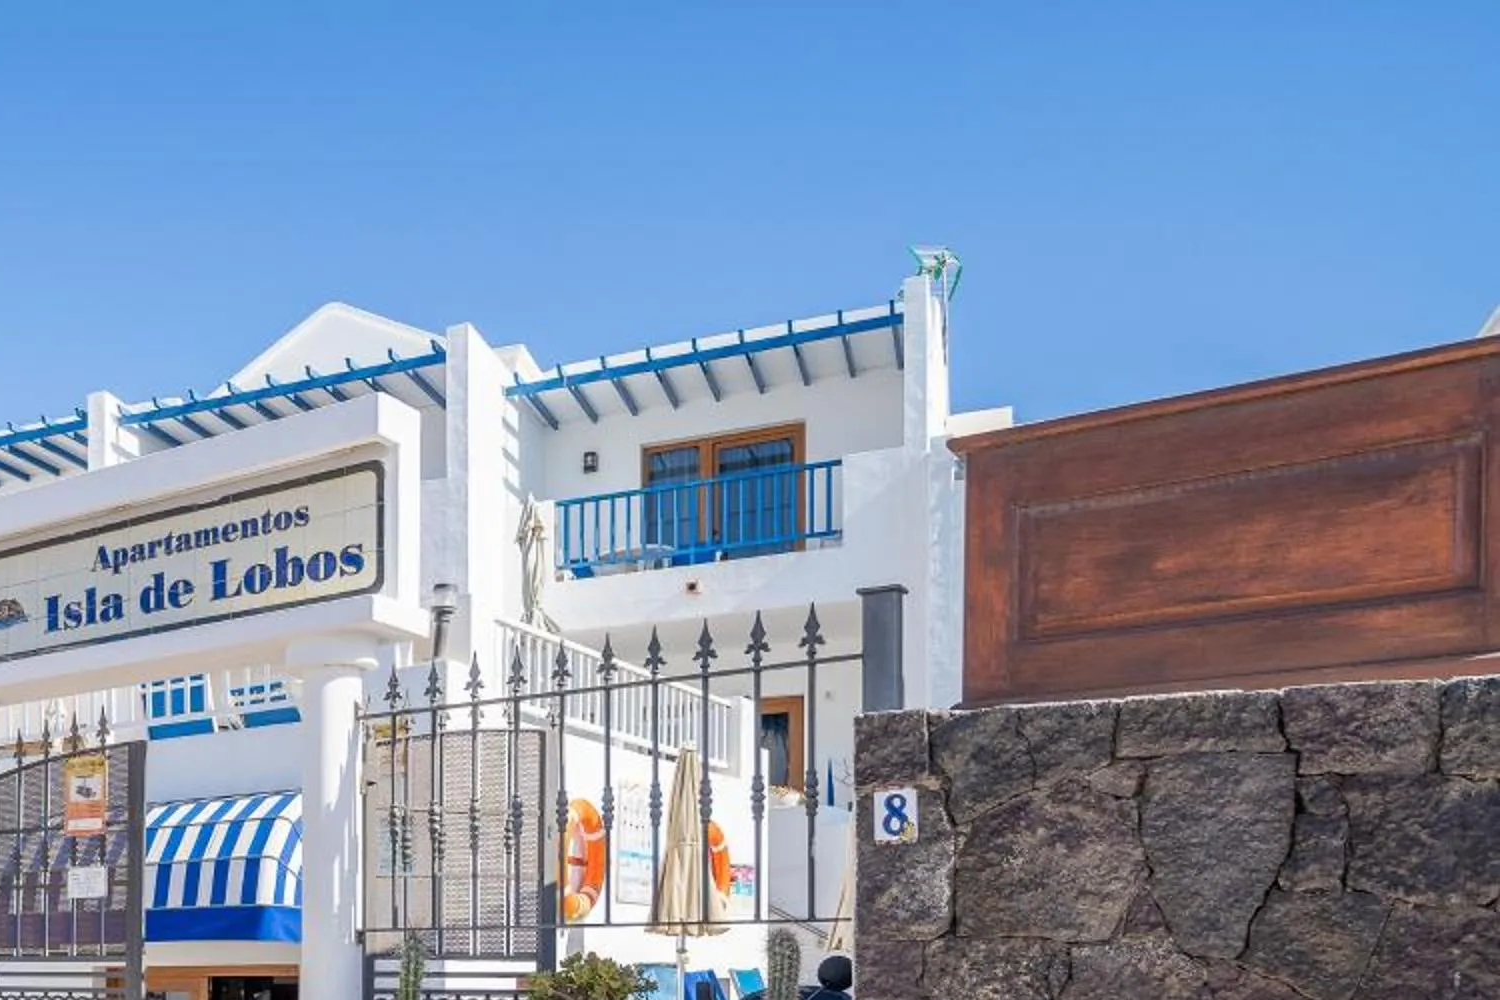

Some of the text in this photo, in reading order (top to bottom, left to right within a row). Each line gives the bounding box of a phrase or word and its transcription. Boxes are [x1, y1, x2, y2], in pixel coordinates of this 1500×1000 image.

[91, 505, 310, 574] Apartamentos
[44, 543, 366, 634] Isla de Lobos
[882, 793, 908, 837] 8
